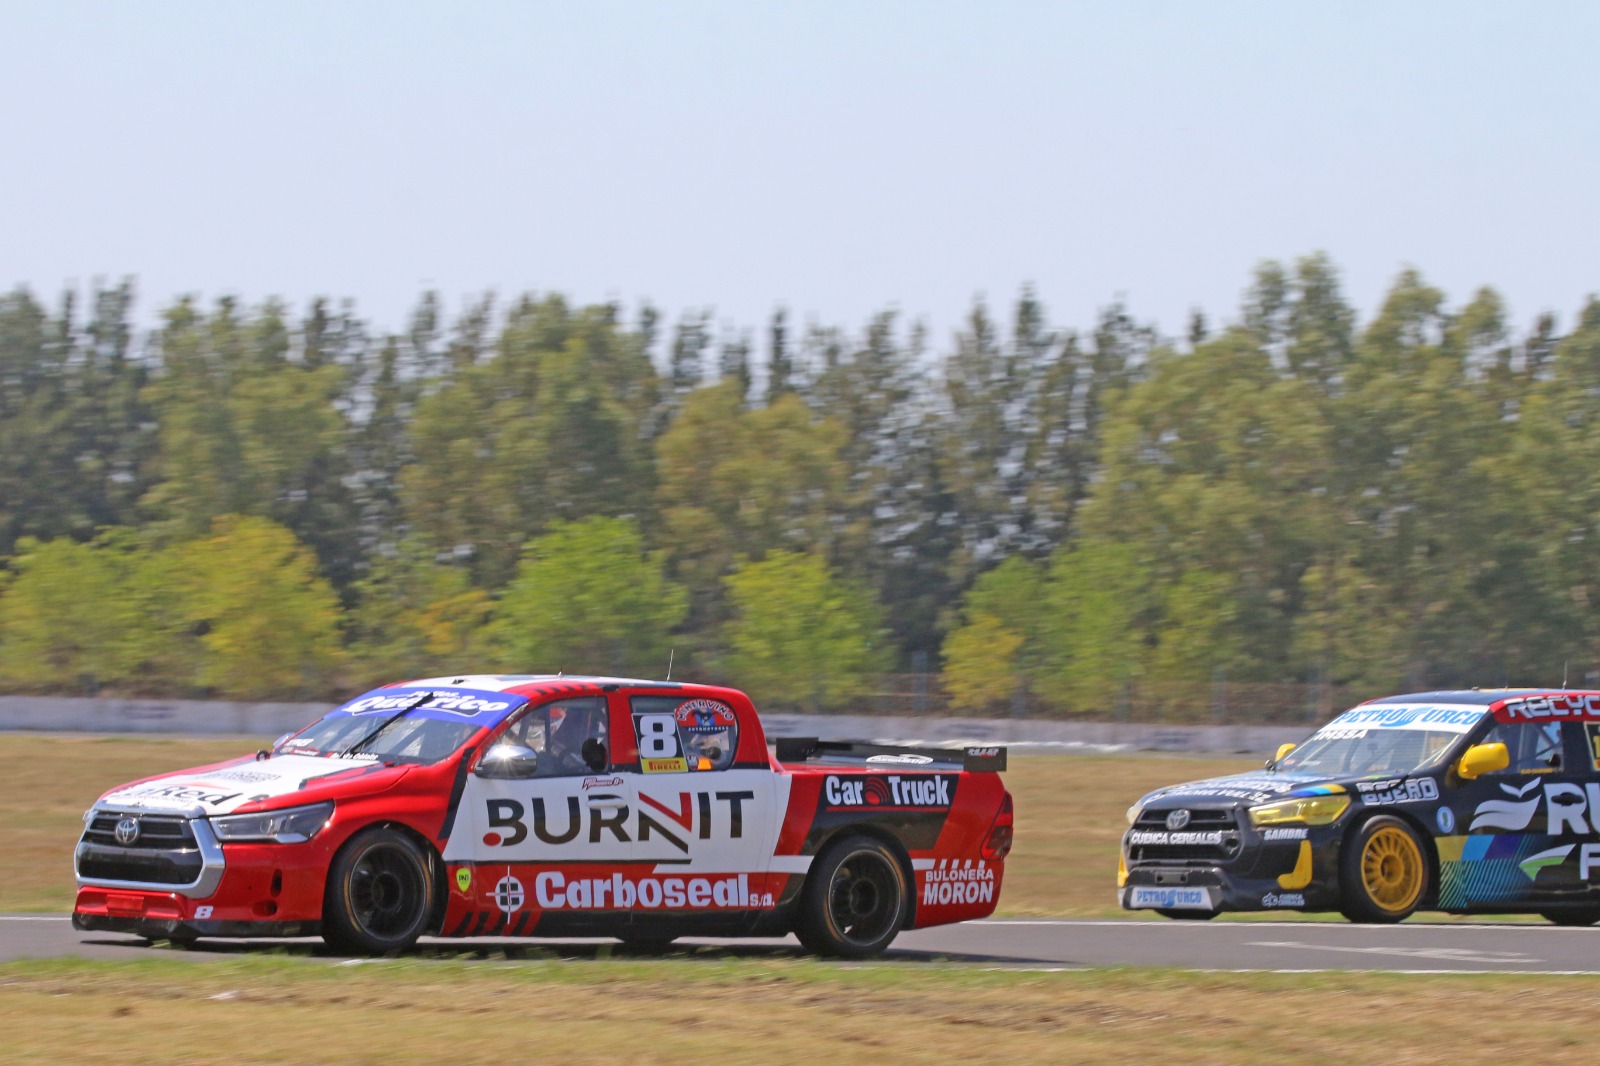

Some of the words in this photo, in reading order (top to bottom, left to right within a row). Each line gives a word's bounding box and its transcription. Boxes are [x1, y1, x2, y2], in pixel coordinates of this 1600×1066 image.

[640, 715, 677, 758] 8
[649, 760, 681, 771] PIRELLI
[826, 775, 863, 805] Car
[888, 775, 949, 805] Truck
[484, 790, 754, 855] BURNIT
[1131, 832, 1168, 844] CUENCA
[1170, 832, 1222, 845] CEREALES
[1264, 829, 1309, 841] SAMBRE
[925, 868, 994, 882] BULONERA
[535, 871, 748, 909] Carboseal
[923, 881, 994, 905] MORON
[193, 904, 213, 919] 8
